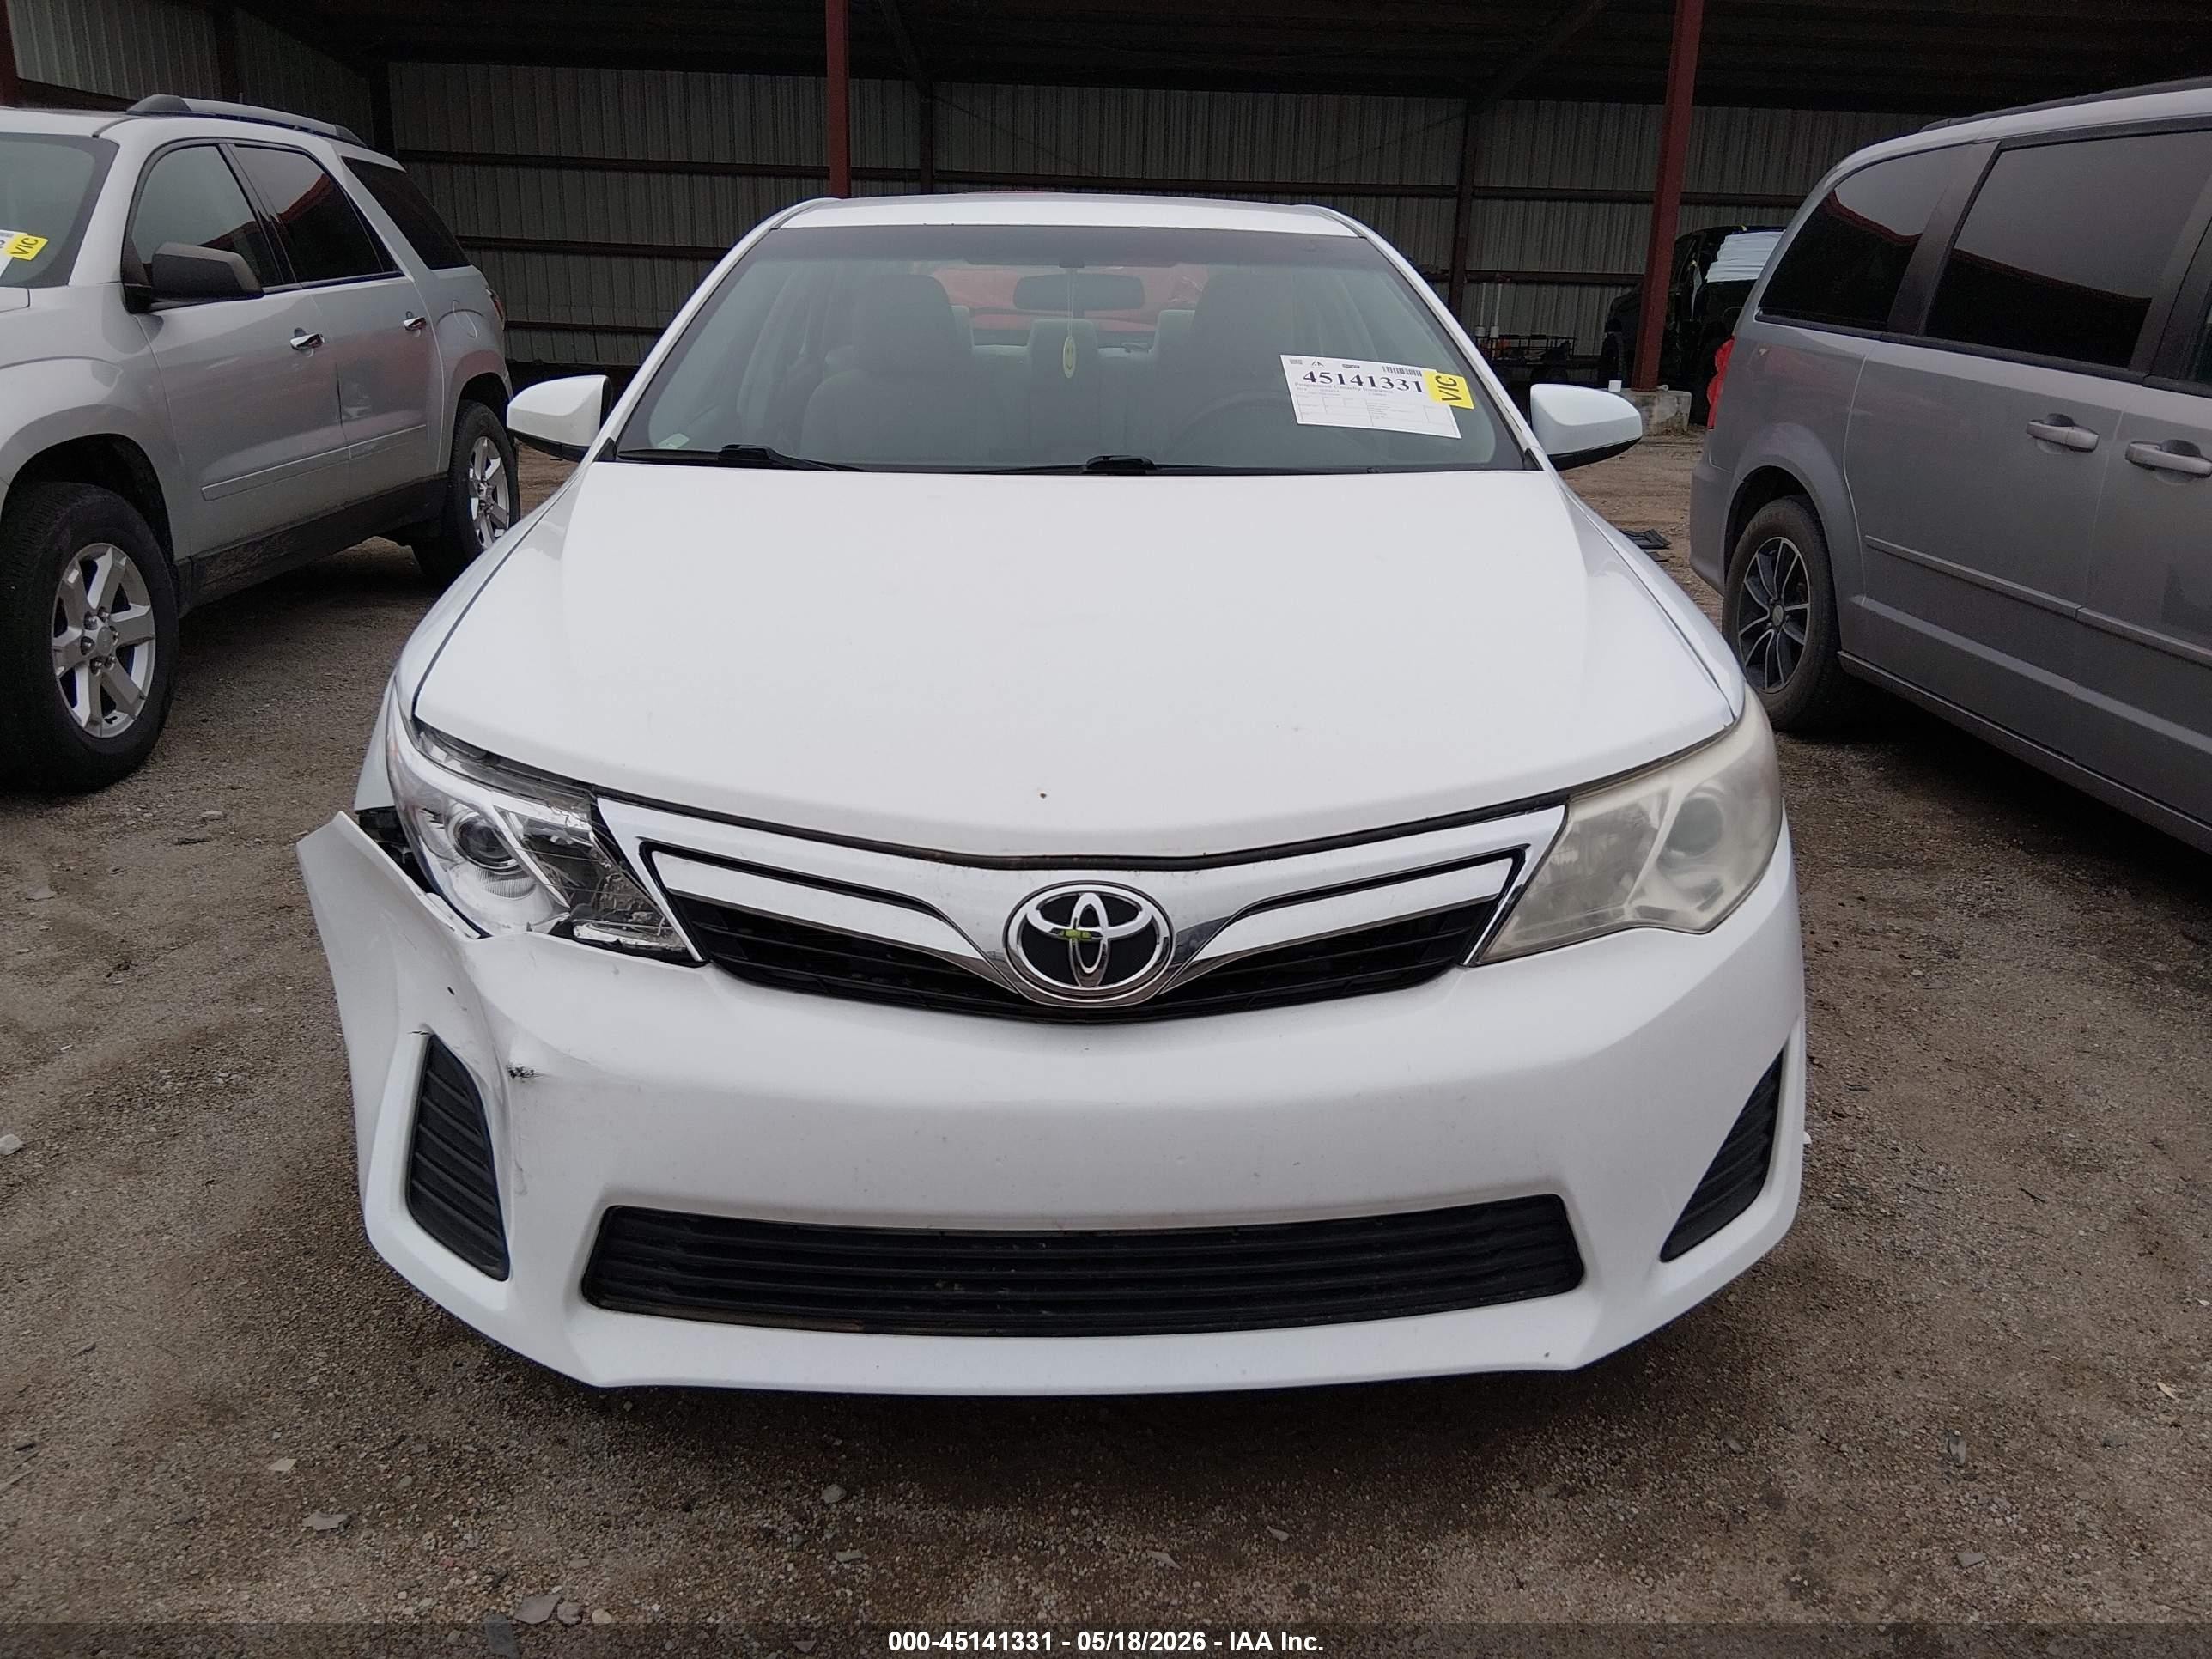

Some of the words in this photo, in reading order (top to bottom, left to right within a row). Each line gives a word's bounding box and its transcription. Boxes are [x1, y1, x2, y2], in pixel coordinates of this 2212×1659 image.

[9, 237, 38, 255] VIC
[1303, 370, 1425, 393] 45141331
[1435, 375, 1462, 401] VIC
